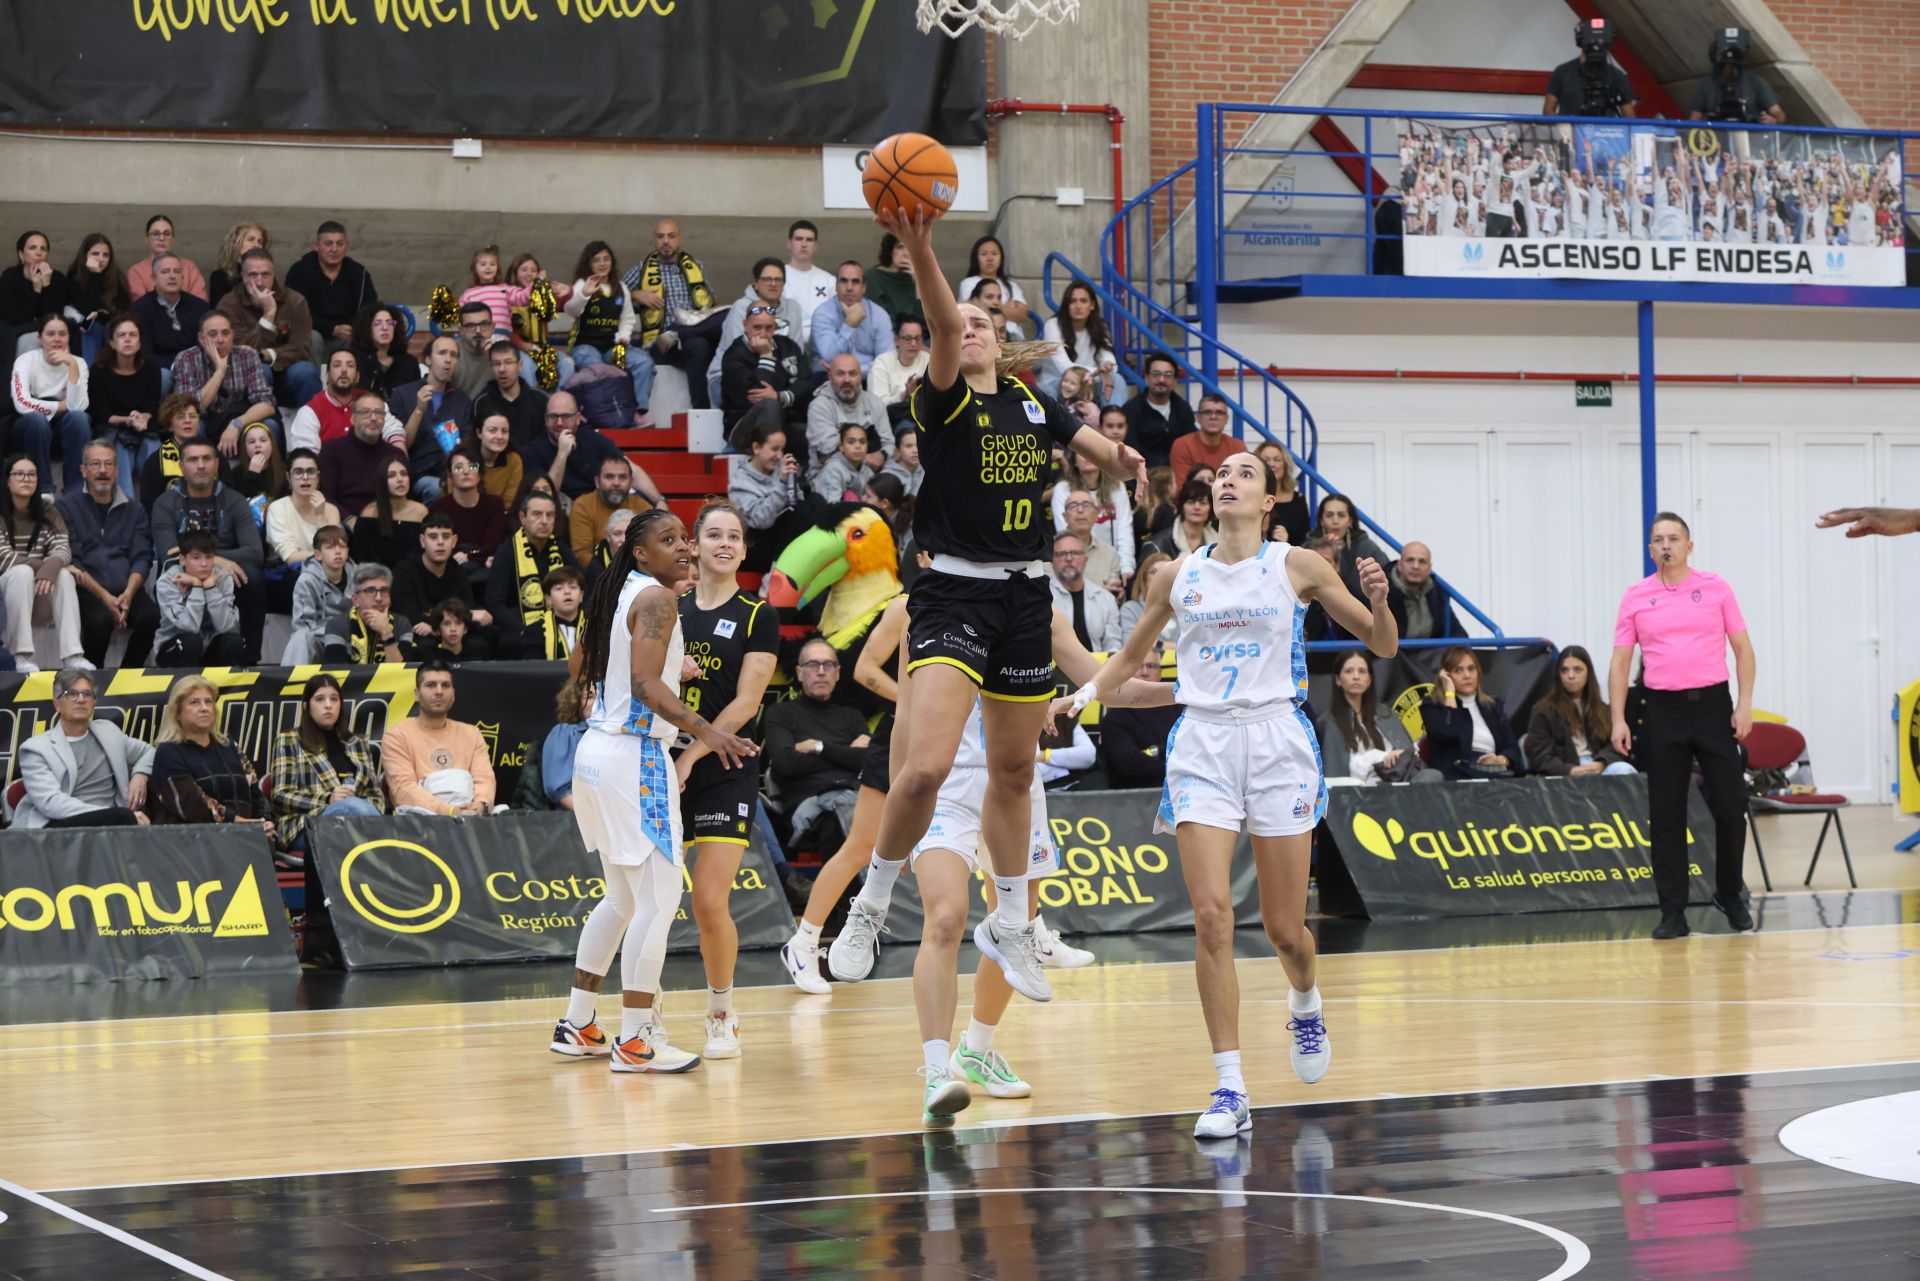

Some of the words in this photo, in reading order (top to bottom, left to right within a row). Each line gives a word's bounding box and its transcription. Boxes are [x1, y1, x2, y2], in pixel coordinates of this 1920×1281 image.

[309, 0, 357, 25] a
[1243, 232, 1321, 246] Alcantarilla
[1498, 243, 1641, 270] ASCENSO
[1651, 247, 1686, 271] LF
[1696, 248, 1813, 274] ENDESA
[1576, 385, 1612, 399] SALIDA
[981, 434, 1037, 451] GRUPO
[981, 449, 1047, 467] HOZONO
[980, 466, 1037, 483] GLOBAL
[1002, 498, 1032, 532] 10
[1184, 610, 1231, 623] CASTILLA
[1236, 609, 1244, 619] Y
[1248, 604, 1278, 617] LEÓN
[1218, 620, 1251, 630] IMPULSA
[683, 641, 711, 655] UPO
[943, 632, 966, 646] Costa
[692, 654, 722, 671] ONO
[1221, 665, 1239, 700] 7
[694, 812, 731, 822] cantarilla
[1409, 812, 1695, 871] quirónsalu
[1053, 844, 1169, 878] ONO
[486, 871, 608, 902] Costa
[1446, 874, 1471, 889] La
[1474, 869, 1526, 888] salud
[1529, 867, 1607, 888] persona
[1610, 867, 1624, 880] a
[981, 873, 1155, 908] OBAL
[121, 928, 136, 936] en
[138, 920, 213, 936] fotocopiadoras
[221, 923, 263, 931] SHARP
[500, 912, 577, 933] Región
